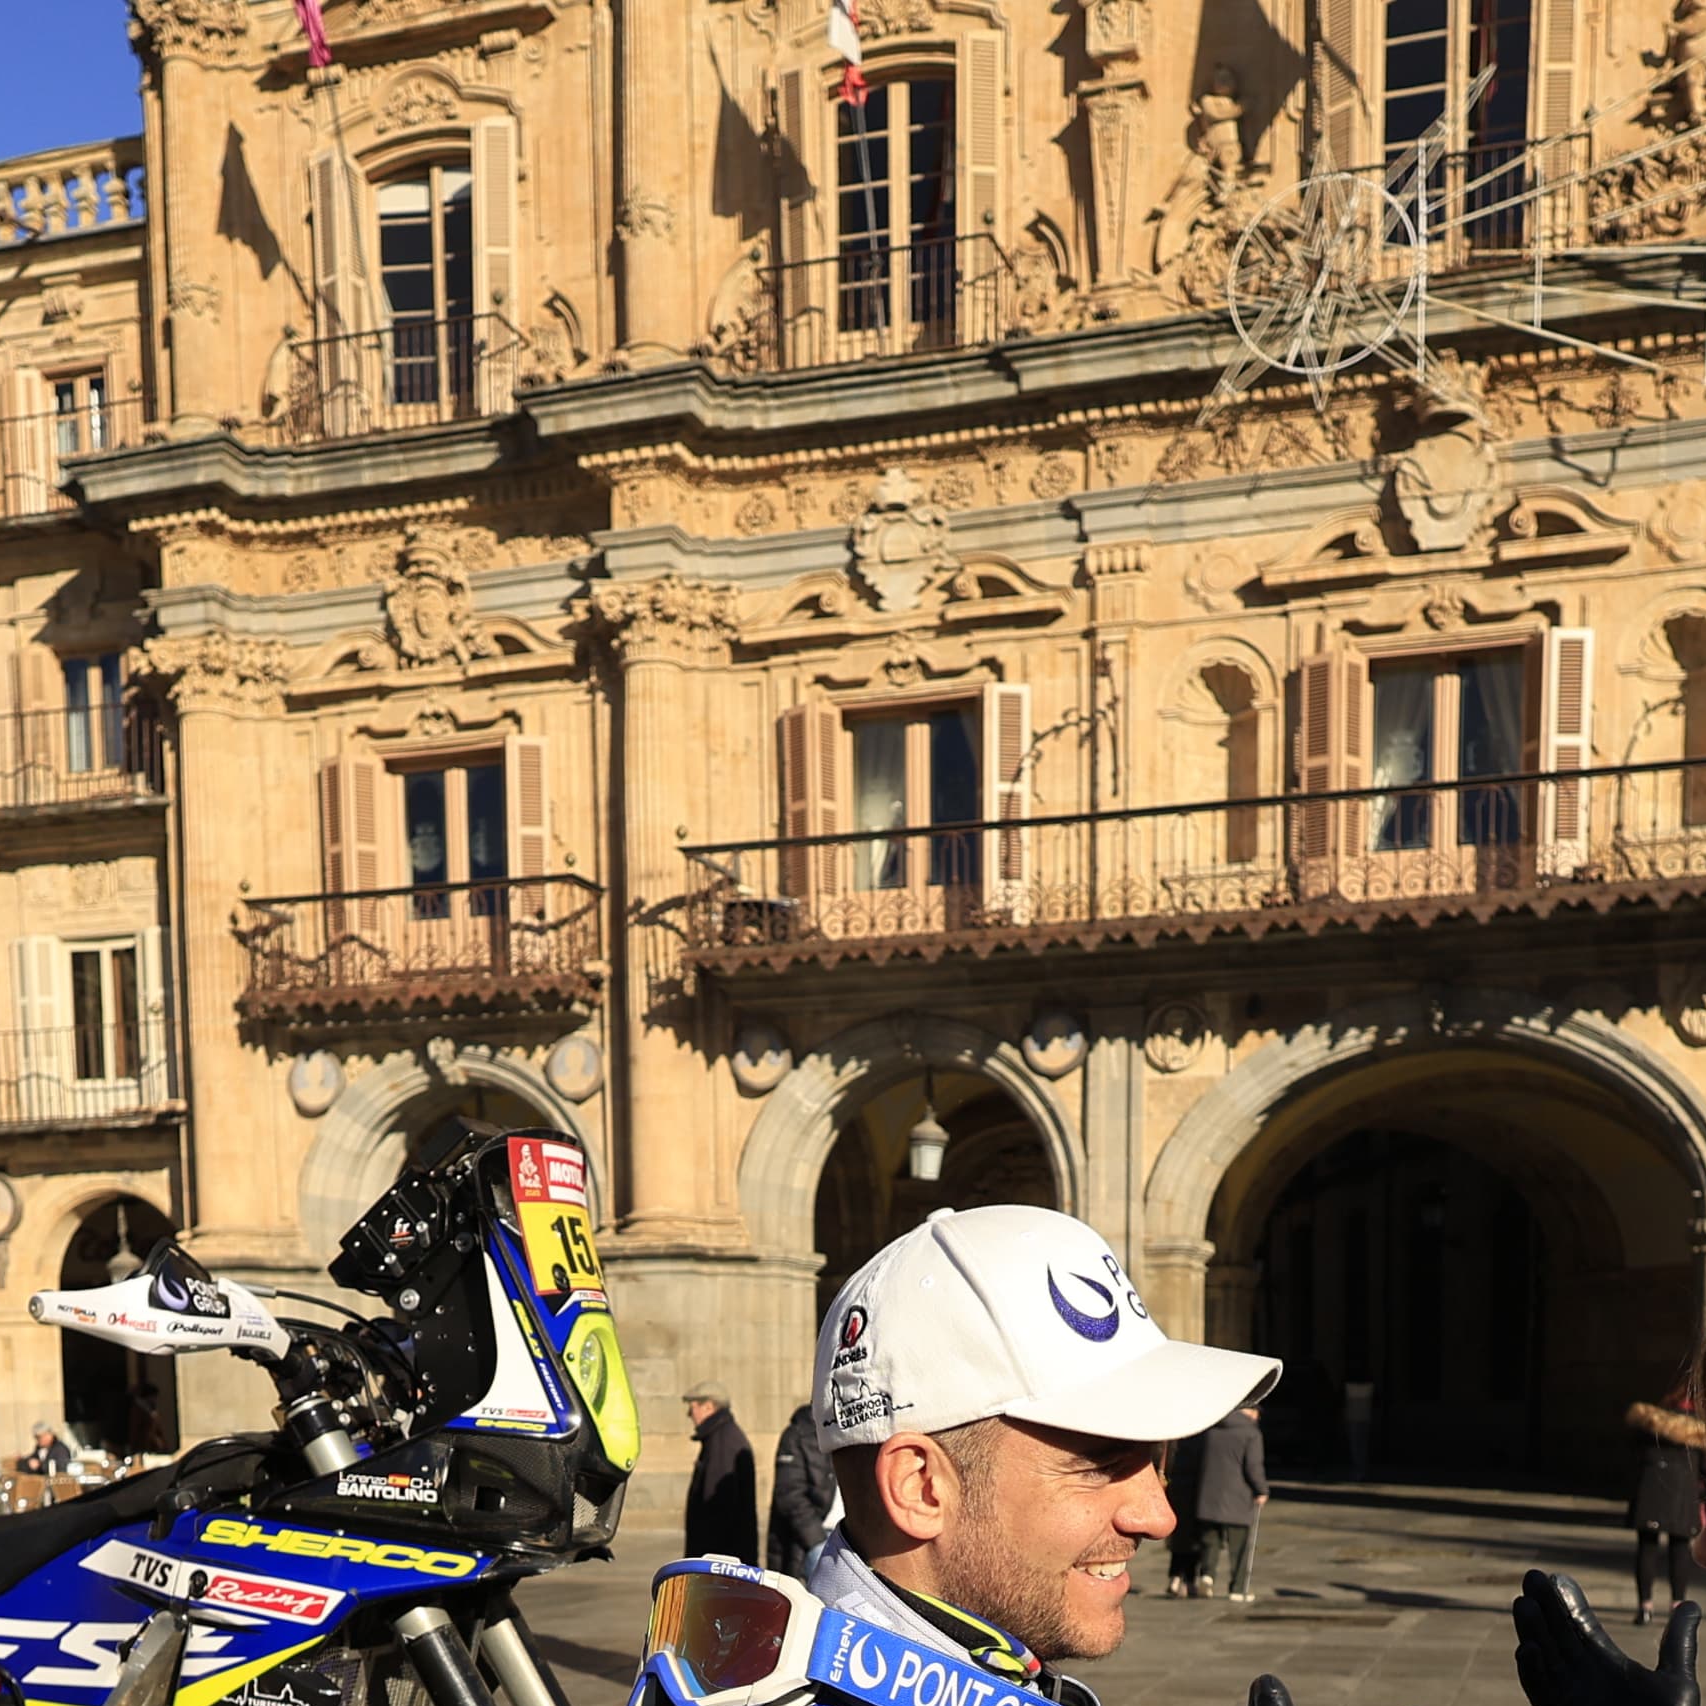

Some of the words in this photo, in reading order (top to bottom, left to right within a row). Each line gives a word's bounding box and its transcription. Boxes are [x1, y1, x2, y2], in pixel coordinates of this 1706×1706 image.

[551, 1215, 595, 1276] 15
[193, 1294, 227, 1316] GRUP
[481, 1407, 504, 1416] TVS
[339, 1471, 389, 1486] Lorenzo
[337, 1482, 438, 1504] SANTOLINO
[200, 1519, 477, 1577] SHERCO
[129, 1552, 173, 1589] TVS
[207, 1580, 326, 1614] Racing
